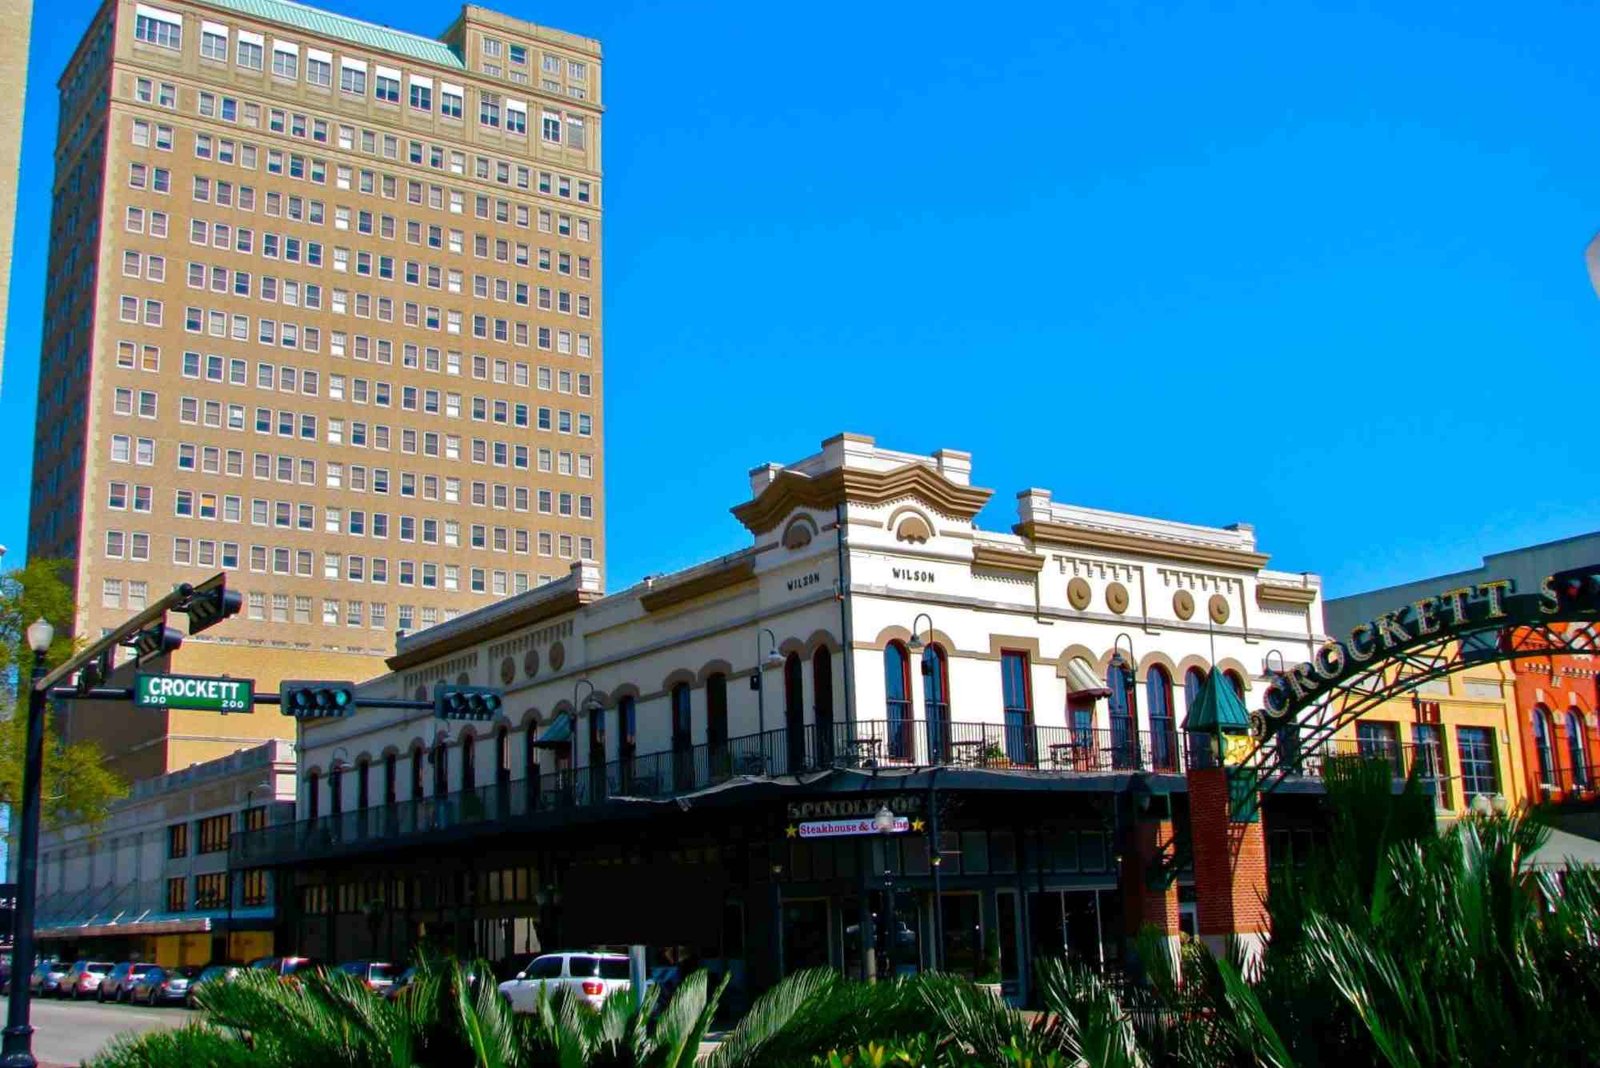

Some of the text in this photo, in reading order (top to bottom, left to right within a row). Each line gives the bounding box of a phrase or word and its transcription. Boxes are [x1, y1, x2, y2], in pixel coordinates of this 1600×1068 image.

[787, 572, 820, 591] WILSON
[892, 567, 935, 583] WILSON
[1263, 578, 1515, 718] CROCKETT
[149, 677, 240, 699] CROCKETT
[143, 695, 244, 708] 300 200
[800, 821, 857, 835] Steakhouse
[858, 821, 869, 832] &
